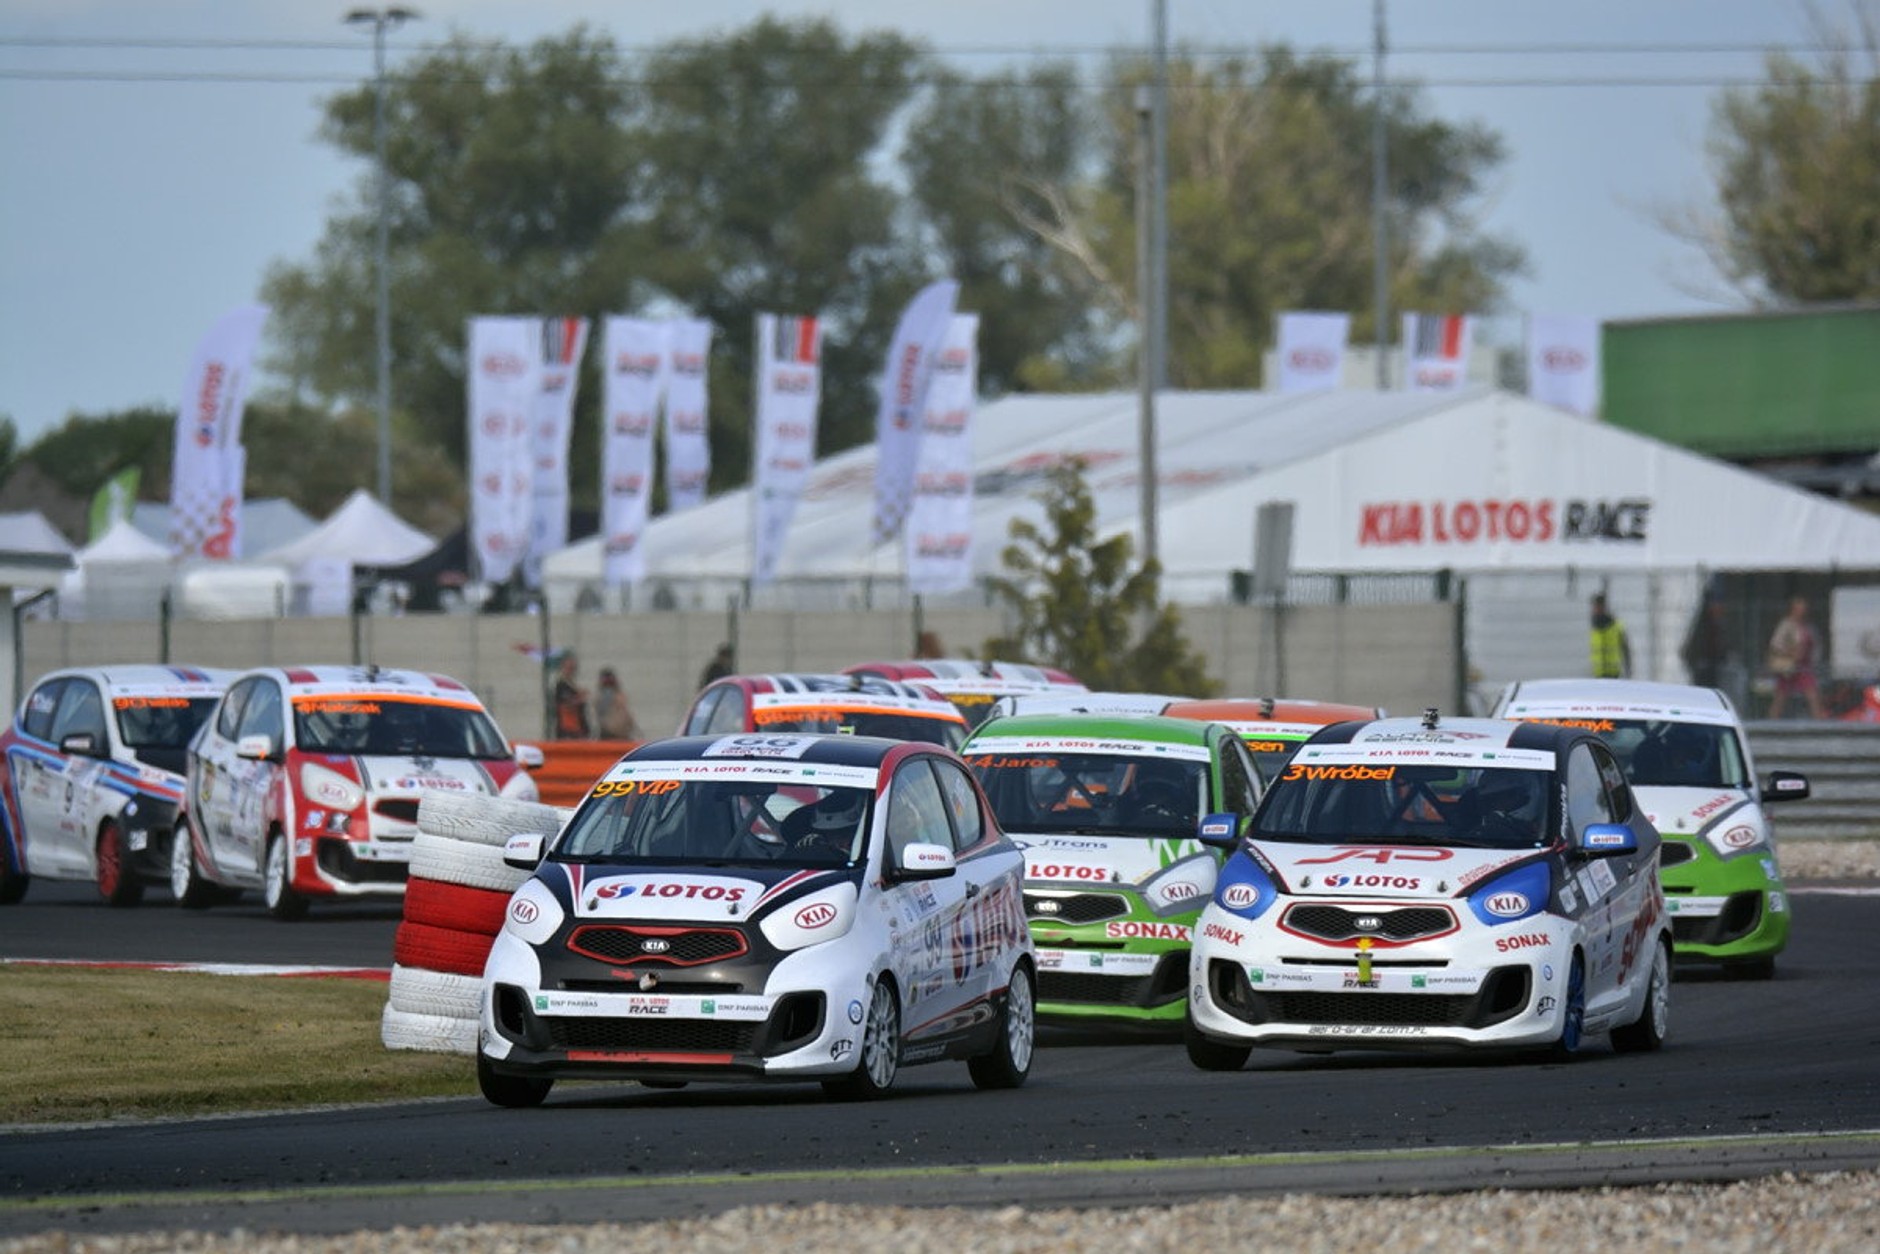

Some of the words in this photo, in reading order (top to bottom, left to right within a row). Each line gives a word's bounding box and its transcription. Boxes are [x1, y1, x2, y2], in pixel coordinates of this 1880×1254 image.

[1360, 504, 1421, 545] KIA
[1432, 500, 1553, 542] LOTOS
[1563, 499, 1651, 542] RACE
[752, 767, 793, 775] RACE
[1030, 864, 1107, 880] LOTOS
[1353, 875, 1420, 889] LOTOS
[641, 883, 746, 901] LOTOS
[1166, 886, 1195, 899] KIA
[1226, 888, 1251, 903] KIA
[513, 903, 535, 919] KIA
[1493, 896, 1523, 911] KIA
[801, 906, 833, 926] KIA
[1358, 918, 1378, 926] KIA
[1107, 923, 1190, 941] SONAX
[1202, 923, 1245, 946] SONAX
[645, 941, 666, 950] KIA
[1495, 932, 1551, 952] SONAX
[1281, 974, 1312, 982] PARIBAS
[567, 1000, 598, 1008] PARIBAS
[629, 1005, 667, 1014] RACE
[718, 1003, 733, 1011] BNP
[735, 1004, 769, 1012] PARIBAS
